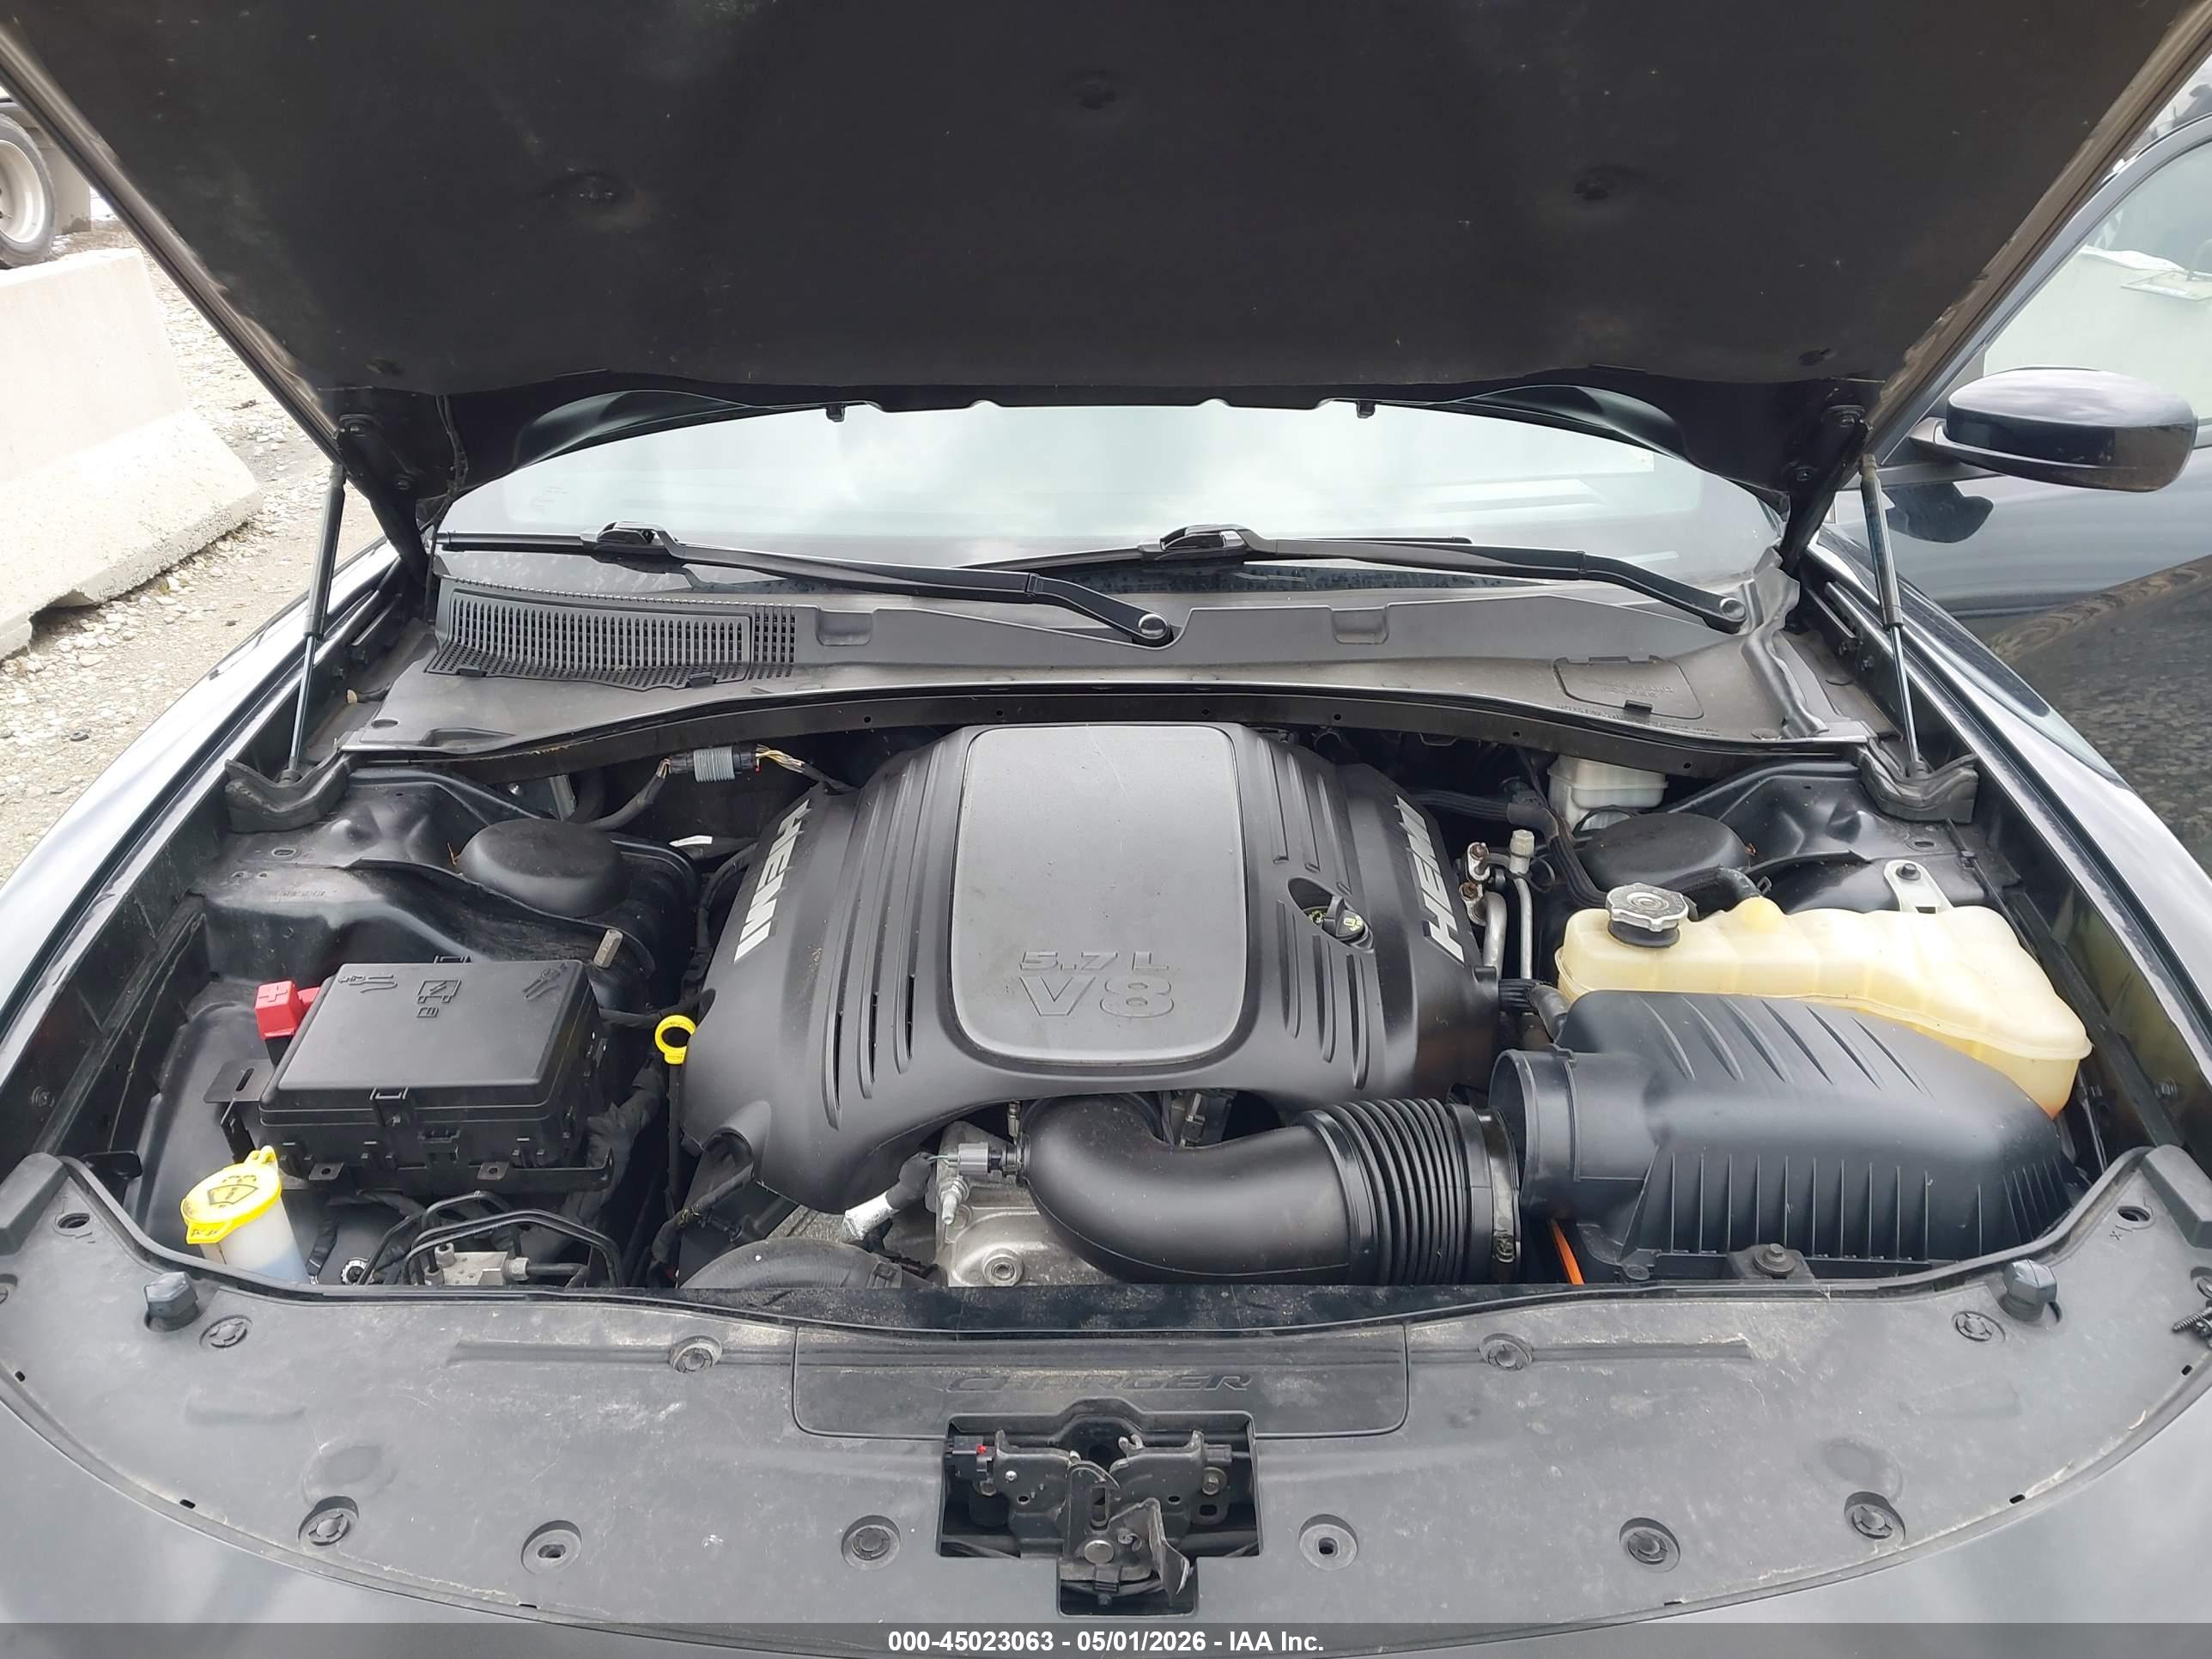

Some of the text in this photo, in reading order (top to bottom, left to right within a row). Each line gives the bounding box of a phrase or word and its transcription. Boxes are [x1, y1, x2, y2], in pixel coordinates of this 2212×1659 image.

[734, 799, 811, 963] HEMI
[1393, 794, 1465, 963] HEMI
[1019, 975, 1175, 1018] V8
[946, 1374, 1252, 1391] CHARGER
